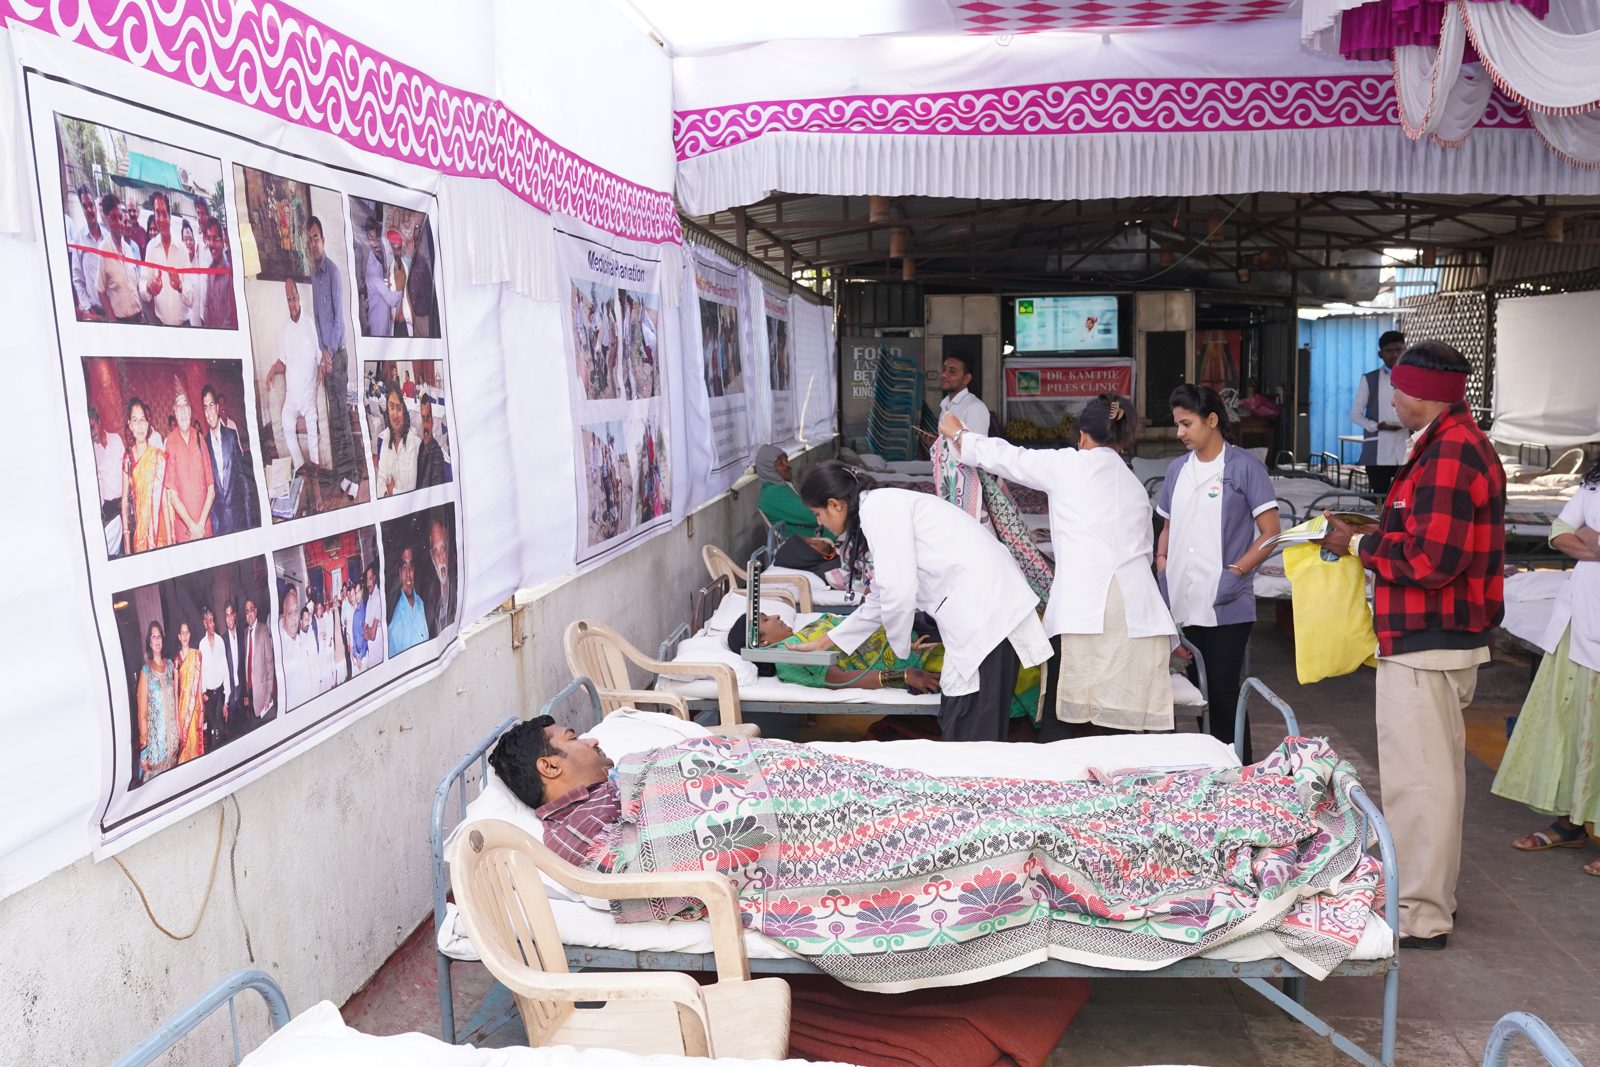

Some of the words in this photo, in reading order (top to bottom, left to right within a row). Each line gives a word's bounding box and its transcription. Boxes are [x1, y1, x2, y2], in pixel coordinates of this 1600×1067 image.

[853, 347, 901, 360] FOD
[853, 370, 876, 381] BET
[1047, 371, 1066, 381] DR.
[1069, 371, 1118, 380] KAMTHE
[852, 386, 875, 397] KING
[1046, 383, 1078, 392] PILES
[1080, 382, 1119, 391] CLINIC
